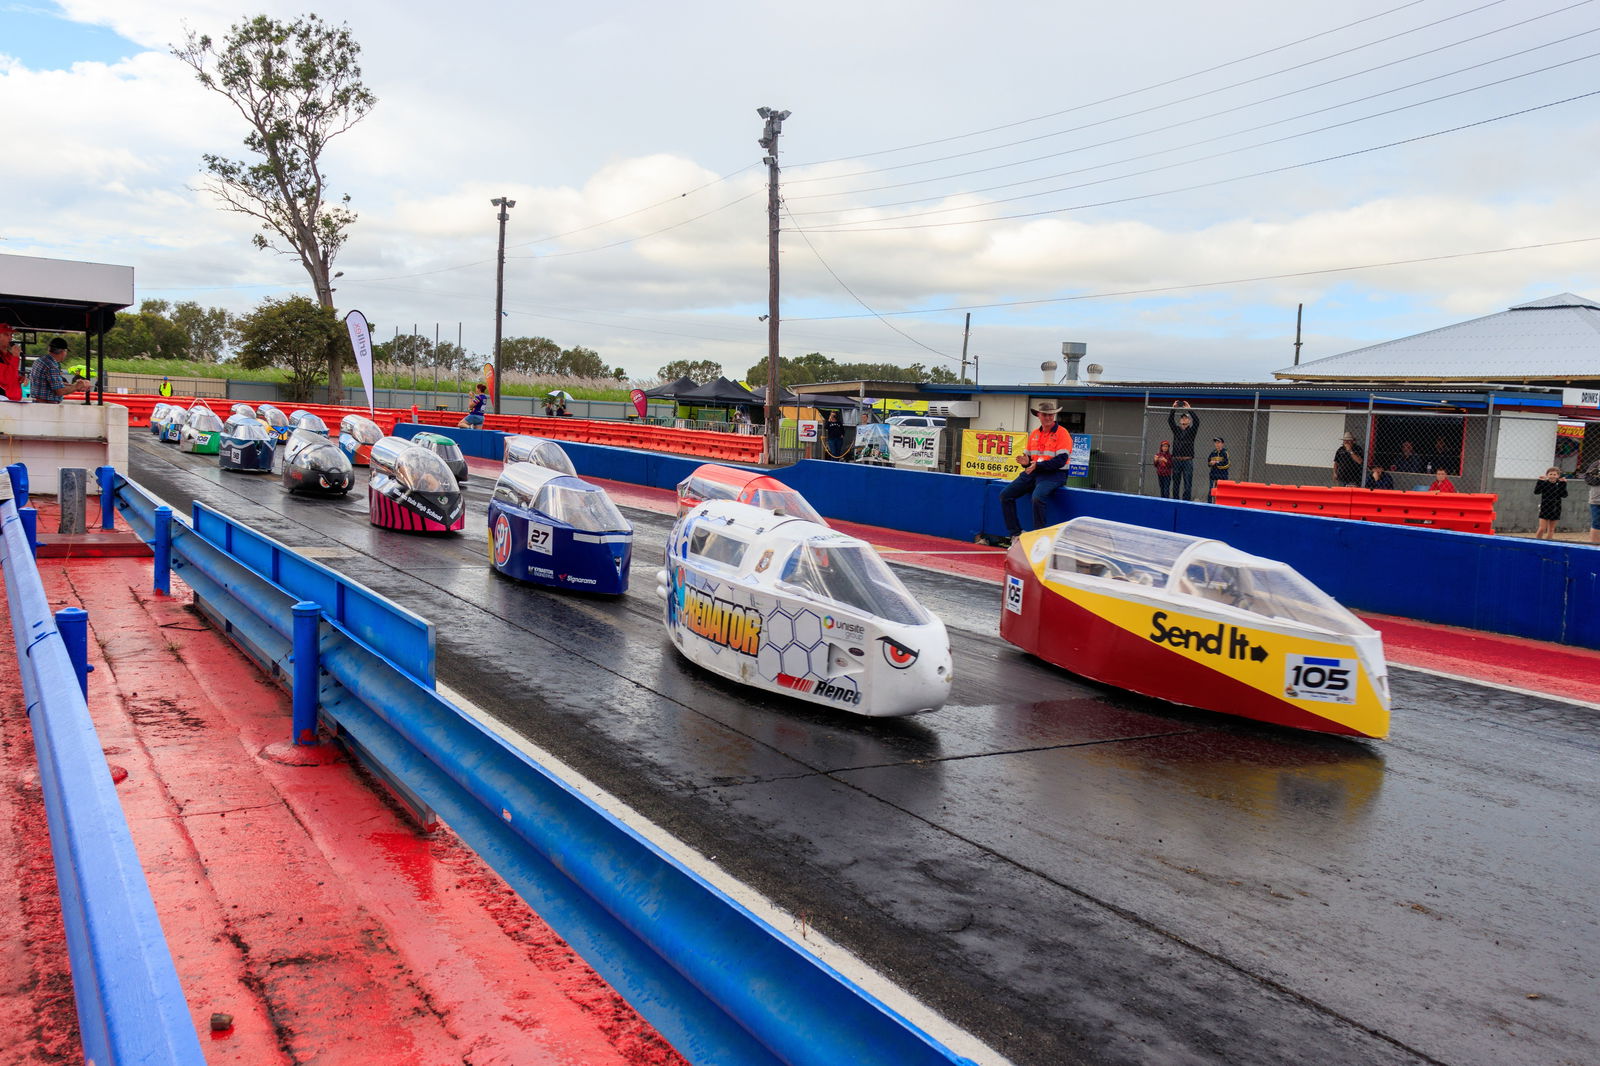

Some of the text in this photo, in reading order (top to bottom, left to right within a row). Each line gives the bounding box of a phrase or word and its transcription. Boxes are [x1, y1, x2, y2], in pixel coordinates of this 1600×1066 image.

[893, 435, 935, 450] PRIME
[976, 433, 1010, 456] TFH
[912, 450, 934, 459] RENTALS
[966, 461, 1019, 473] 0418 666 627
[416, 502, 427, 512] High
[425, 508, 444, 521] School
[530, 529, 550, 545] 27
[566, 575, 597, 584] Signarama
[1007, 583, 1021, 604] 105
[682, 583, 762, 658] PREDATOR
[836, 620, 865, 634] unisite
[1149, 611, 1250, 661] Send It
[1291, 665, 1352, 691] 105
